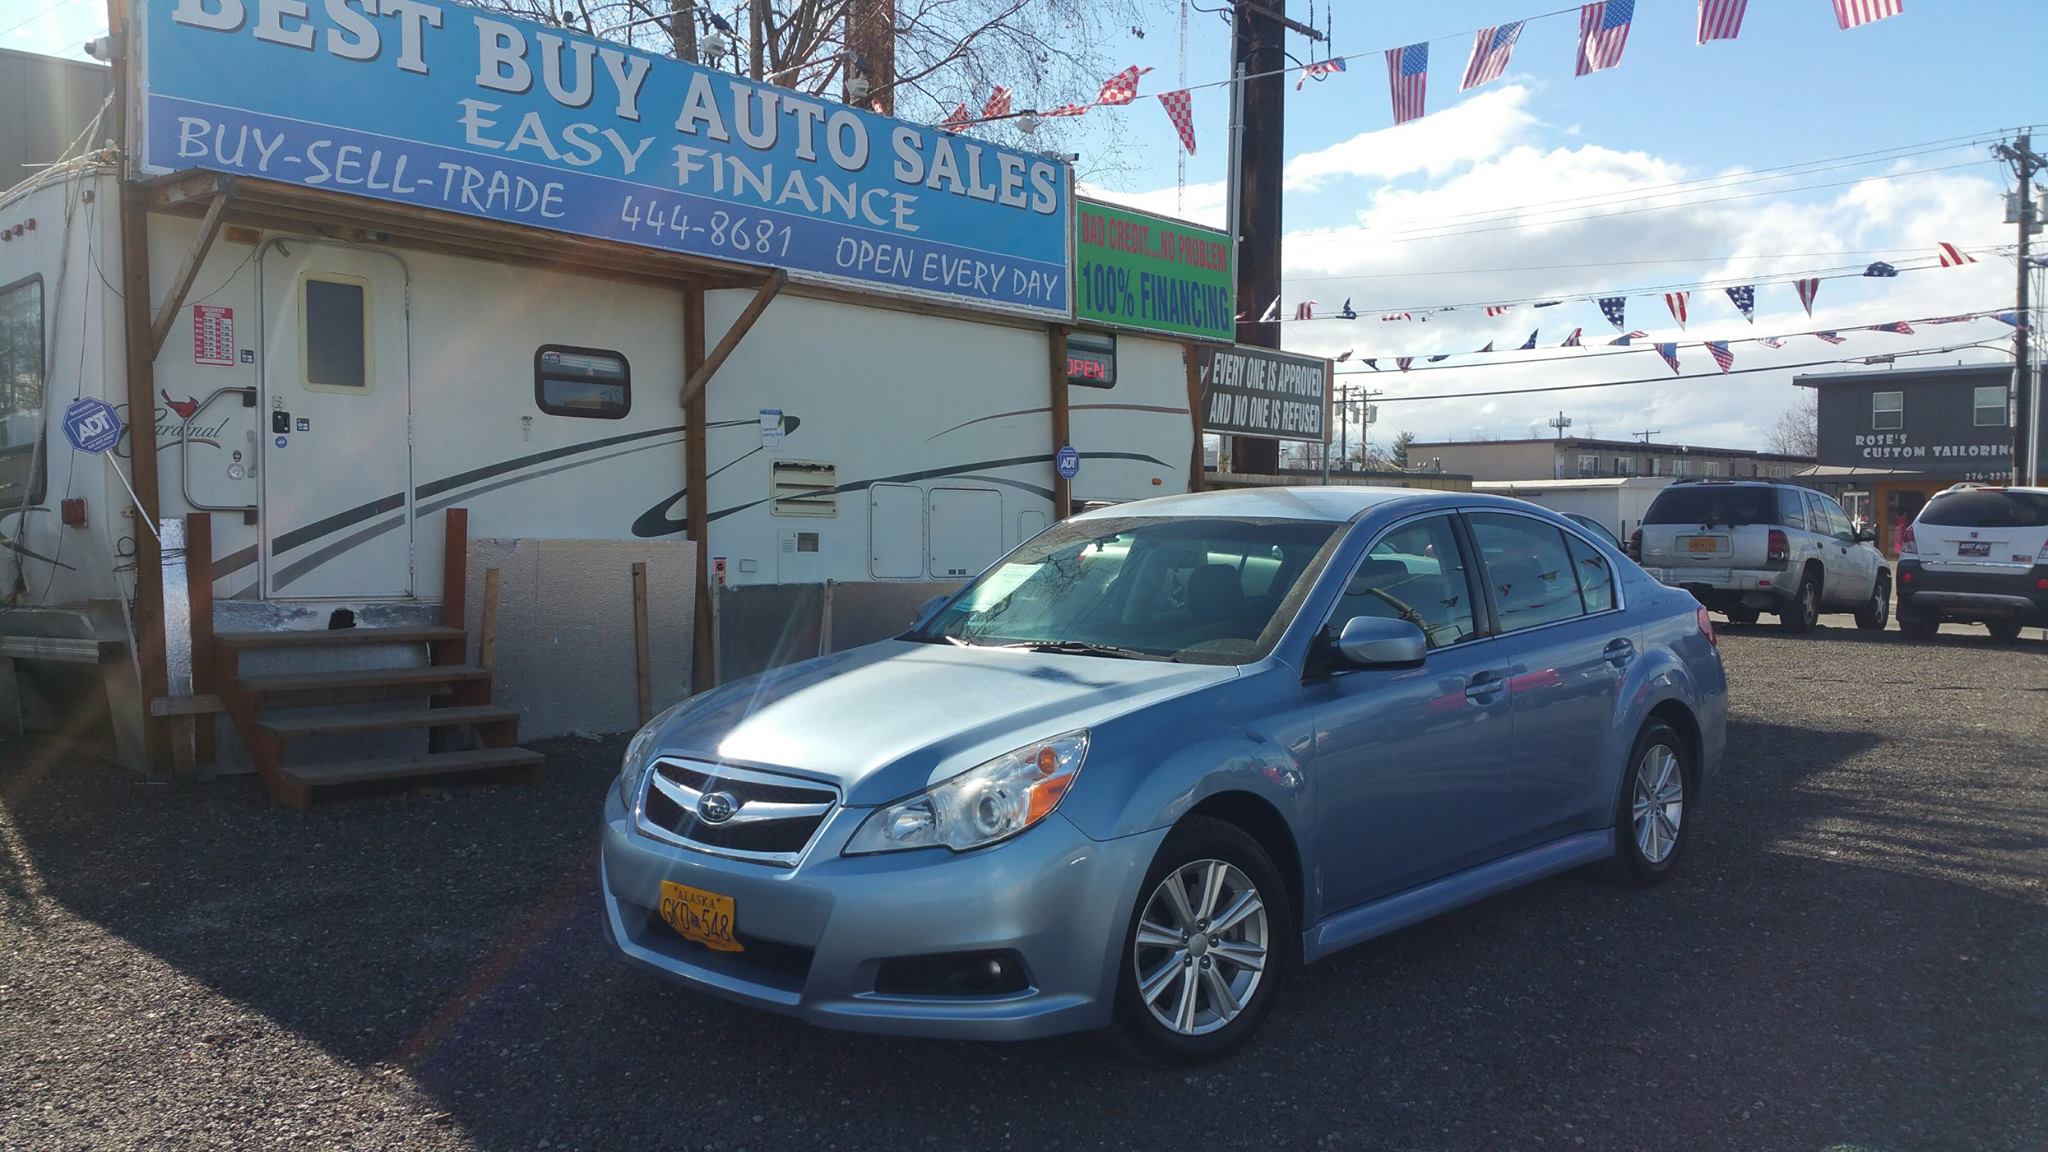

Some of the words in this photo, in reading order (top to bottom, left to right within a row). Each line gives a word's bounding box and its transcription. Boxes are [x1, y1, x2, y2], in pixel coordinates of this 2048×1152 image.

[474, 16, 651, 121] BUY
[675, 71, 870, 171] AUTO
[892, 126, 1056, 214] SALES
[457, 97, 656, 176] EASY
[672, 145, 920, 233] FINANCE
[176, 116, 566, 219] BUY-SELL-TRADE
[621, 196, 792, 257] 444-8681
[836, 237, 914, 279] OPEN
[923, 253, 1006, 294] EVERY
[1013, 269, 1058, 301] DAY
[1081, 212, 1106, 247] BAD
[1178, 235, 1228, 272] PROBLEM
[1083, 261, 1135, 317] 100%
[1140, 271, 1230, 332] FINANCING
[1212, 352, 1246, 387] EVERY
[1246, 357, 1266, 390] ONE
[1266, 360, 1277, 392] IS
[1277, 363, 1322, 397] APPROVED
[79, 409, 111, 443] ADT
[1208, 392, 1232, 425] AND
[1232, 395, 1248, 427] NO
[1249, 396, 1270, 429] ONE
[1270, 399, 1280, 430] IS
[1281, 401, 1320, 433] REFUSED
[1855, 433, 1908, 446] ROSE'S
[1863, 446, 1926, 458] CUSTOM
[1061, 456, 1076, 469] ADT
[677, 890, 716, 910] ALASKA
